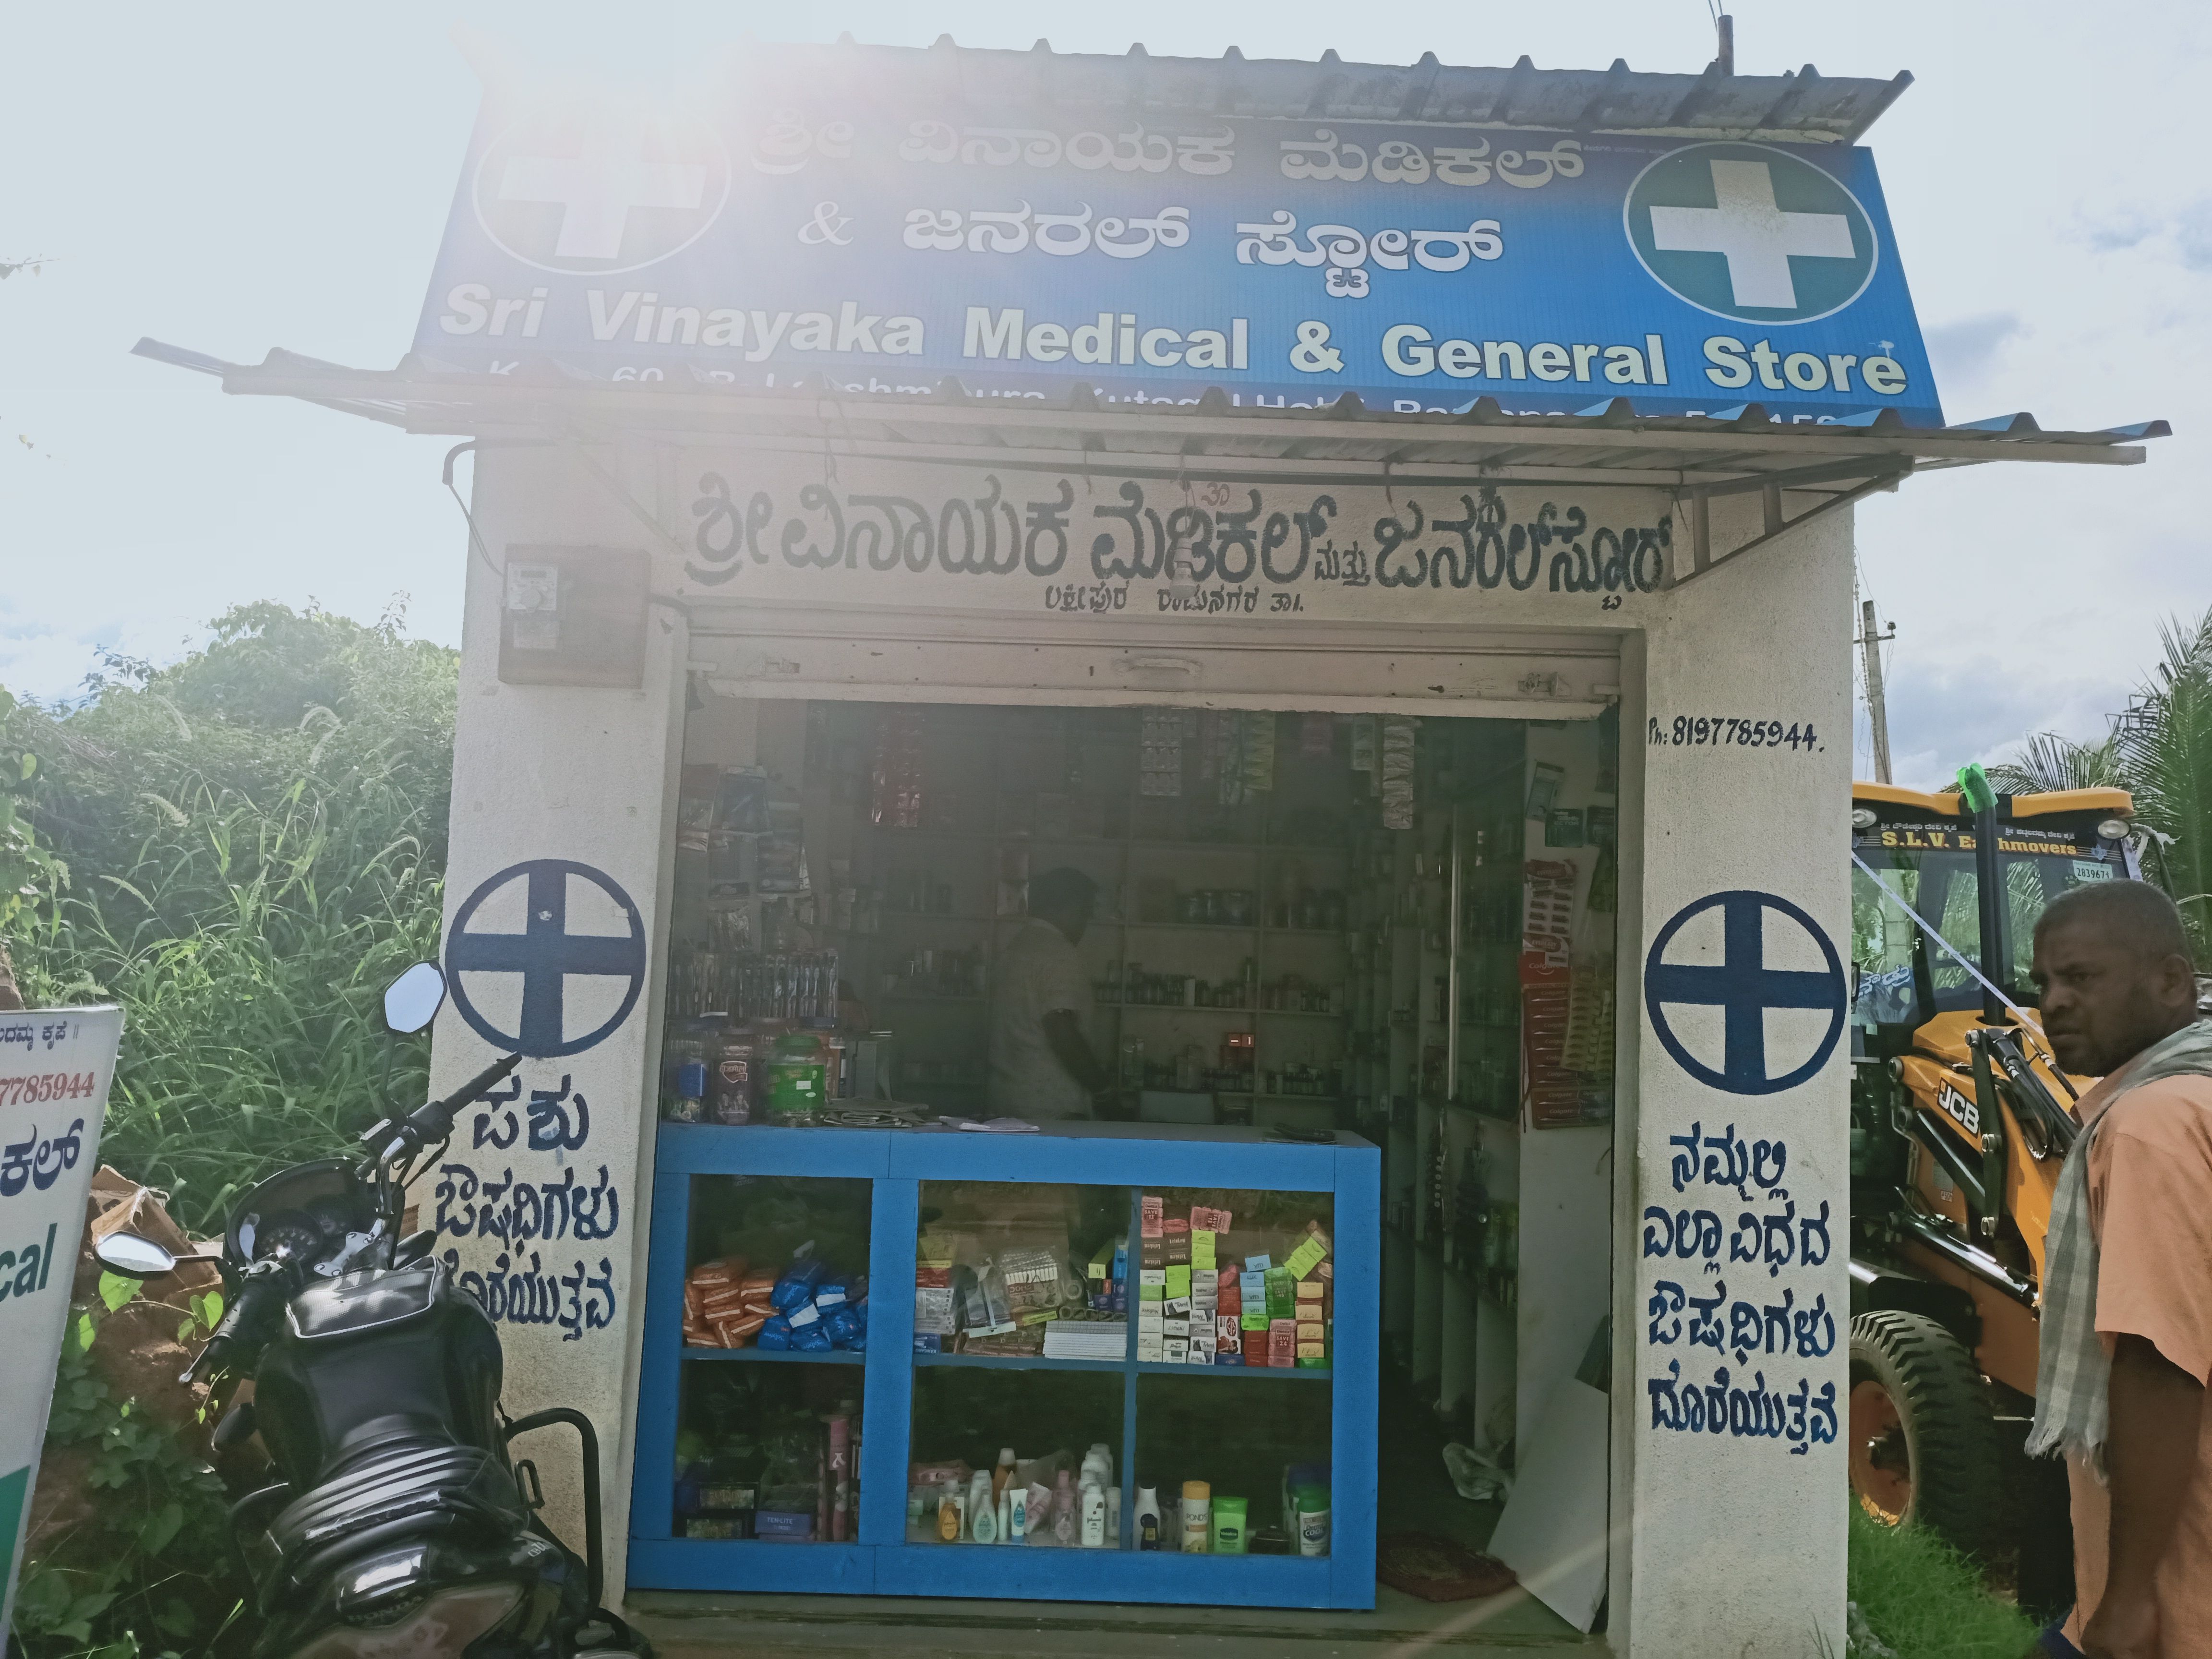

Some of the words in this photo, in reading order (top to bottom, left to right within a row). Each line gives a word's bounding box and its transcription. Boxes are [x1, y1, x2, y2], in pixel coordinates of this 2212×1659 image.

[749, 109, 855, 175] ಶ್ರೀ
[899, 118, 1236, 176] ವಿನಾಯಕ
[1279, 129, 1585, 189] ಮೆಡಿಕಲ್
[798, 201, 854, 246] &
[903, 198, 1190, 259] ಜನರಲ್
[1236, 210, 1504, 299] ಸ್ಟೋರ್
[439, 283, 548, 339] Sri
[587, 289, 925, 363] Vinayaka
[962, 306, 1249, 371] Medical
[1289, 319, 1345, 374] &
[1382, 324, 1668, 386] General
[1704, 336, 1907, 396] Store
[684, 471, 773, 586] ಶ್ರೀ
[781, 474, 1075, 577] ವಿನಾಯಕ
[1314, 538, 1371, 586] ಮತ್ತು
[1648, 716, 1668, 745] Ph:
[1881, 831, 1950, 848] S.L.V.
[1958, 835, 2078, 855] Ehmovers
[42, 1020, 67, 1050] ಕೃಪೆ
[472, 1073, 589, 1151] ಪಶು
[1937, 1086, 1980, 1135] JCB
[1670, 1120, 1789, 1201] ನಮ್ಮಲ್ಲಿ
[435, 1163, 619, 1258] ಔಷಧಿಗಳು
[1643, 1205, 1723, 1274] ಎಲ್ಲಾ
[1730, 1200, 1831, 1278] ವಿಧದ
[1648, 1279, 1835, 1366] ಔಷಧಿಗಳು
[1648, 1358, 1839, 1455] ದೊರೆಯುತ್ತವೆ
